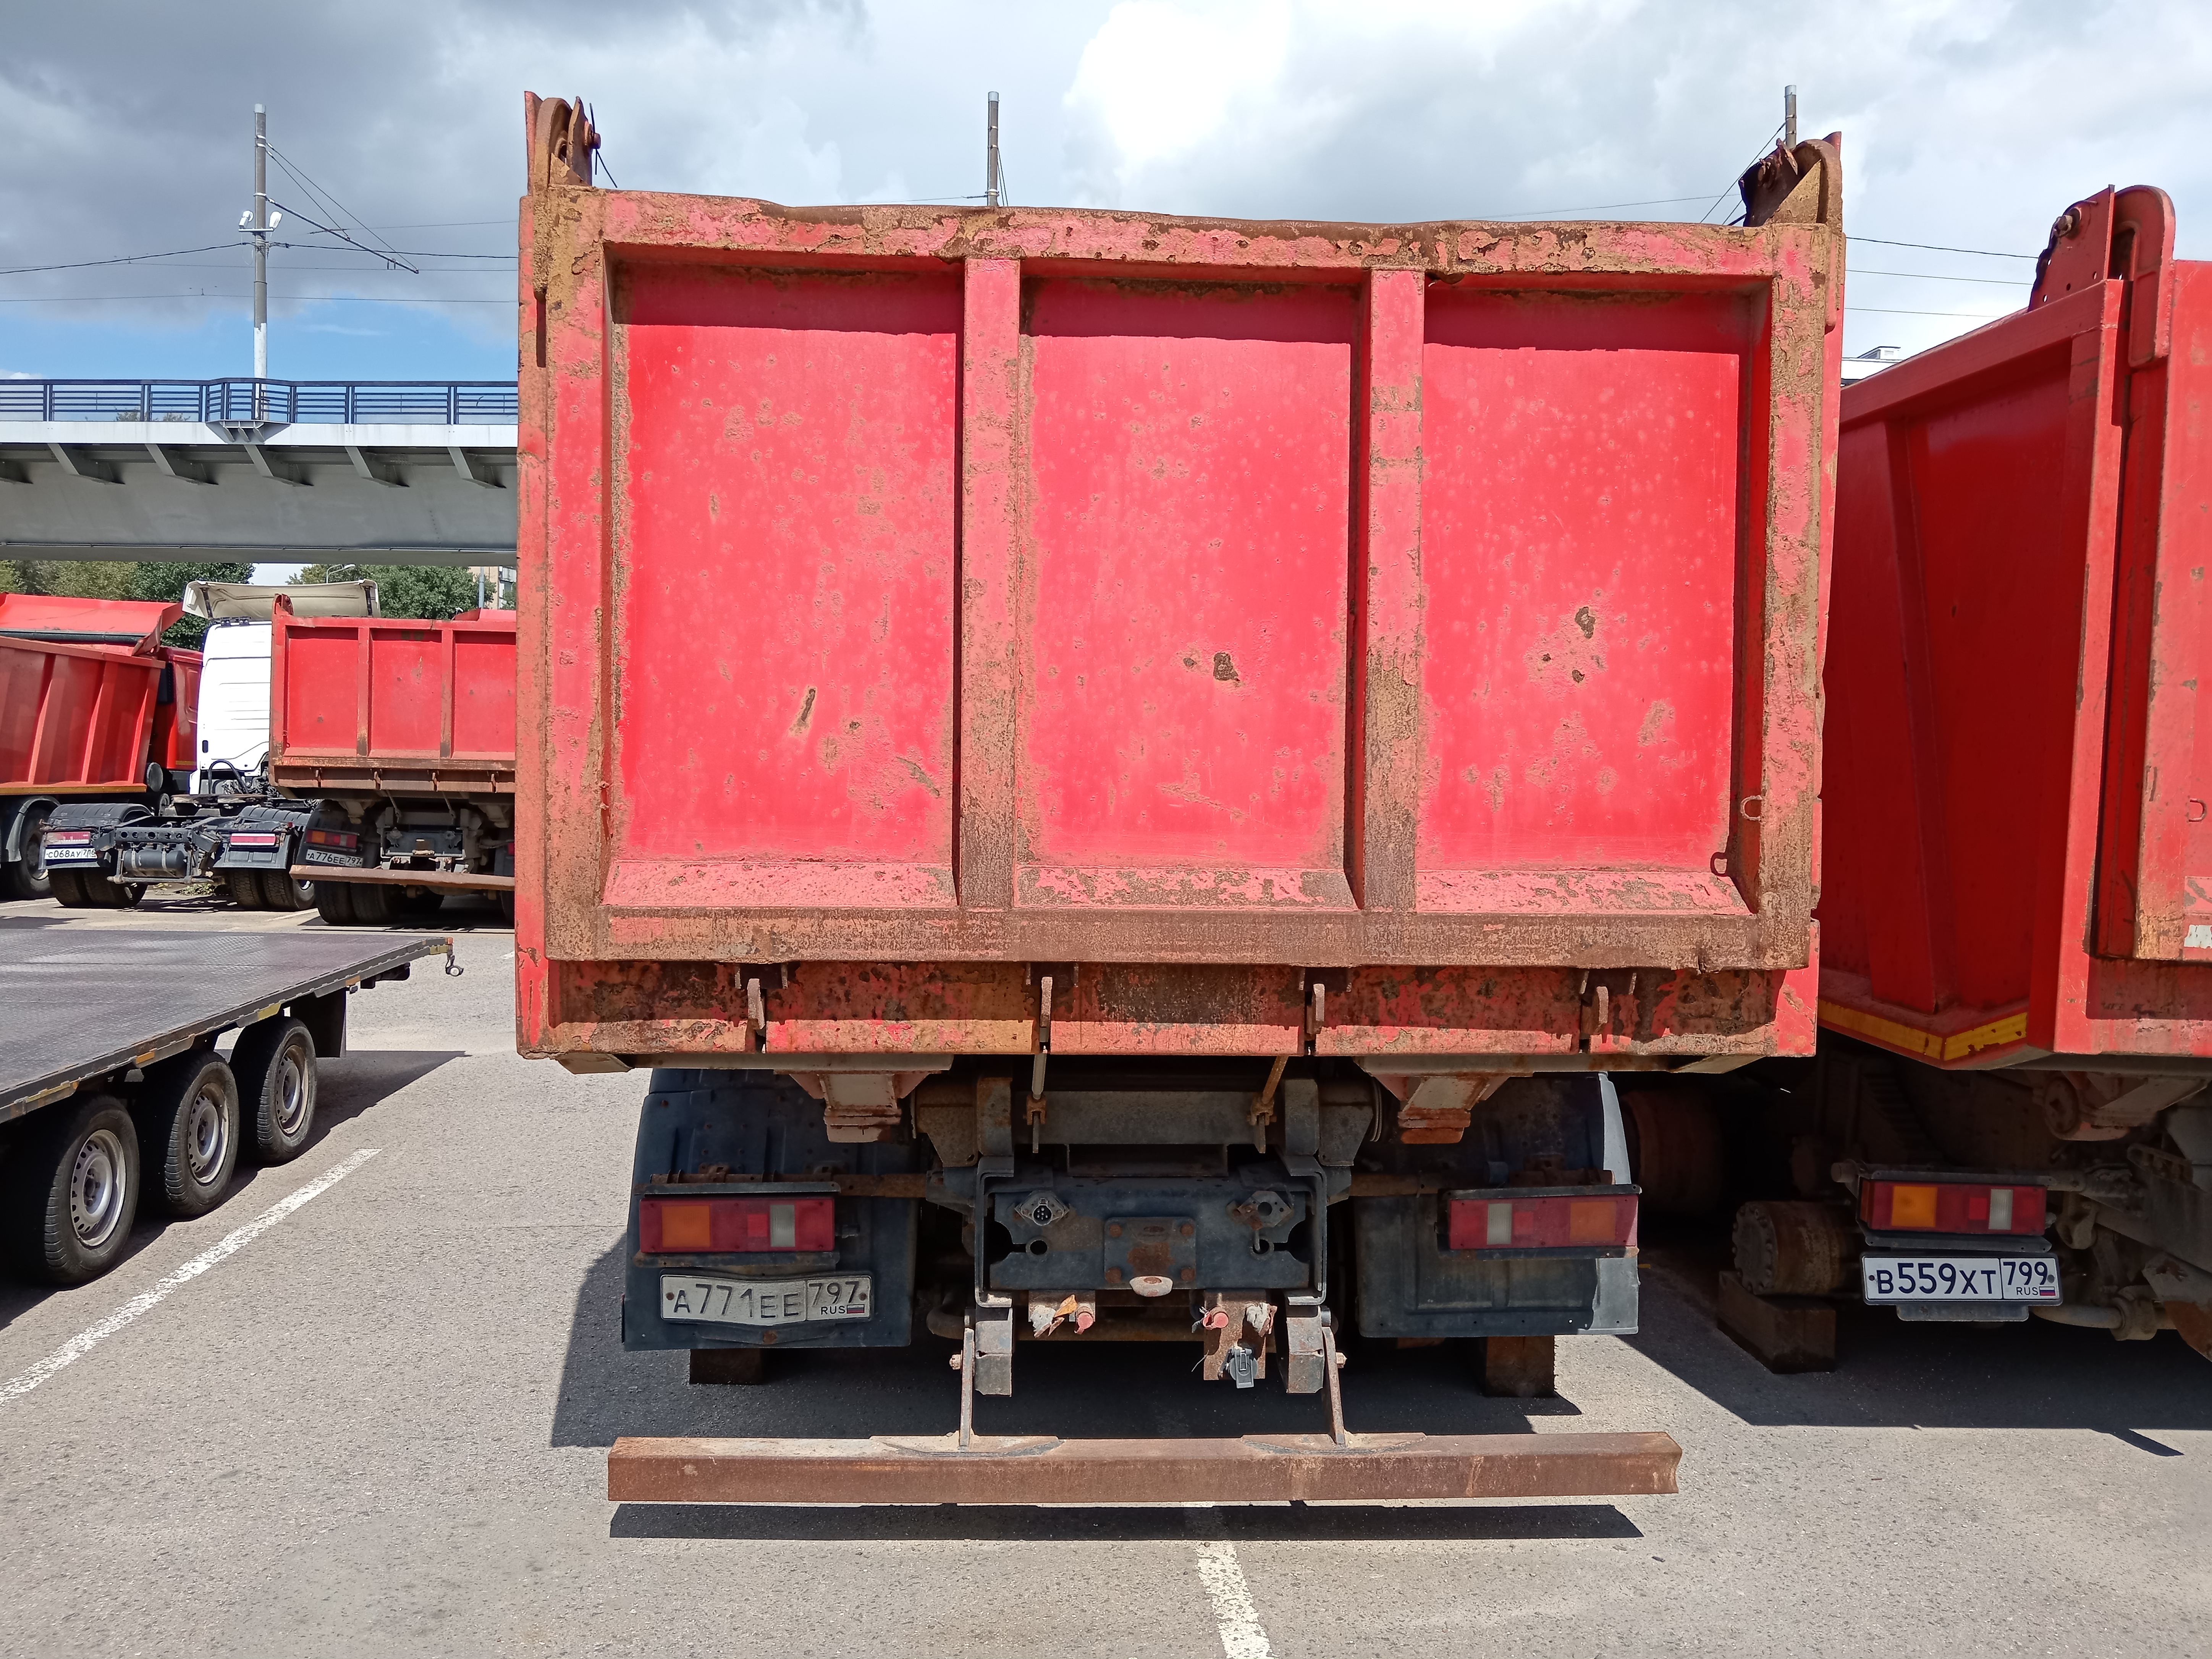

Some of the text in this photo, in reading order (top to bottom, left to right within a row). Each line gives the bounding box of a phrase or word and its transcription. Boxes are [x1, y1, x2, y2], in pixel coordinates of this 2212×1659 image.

[347, 857, 361, 865] 797
[2003, 1261, 2048, 1285] 799
[808, 1281, 860, 1306] 797
[2016, 1287, 2039, 1296] RUS
[821, 1305, 846, 1315] RUS
